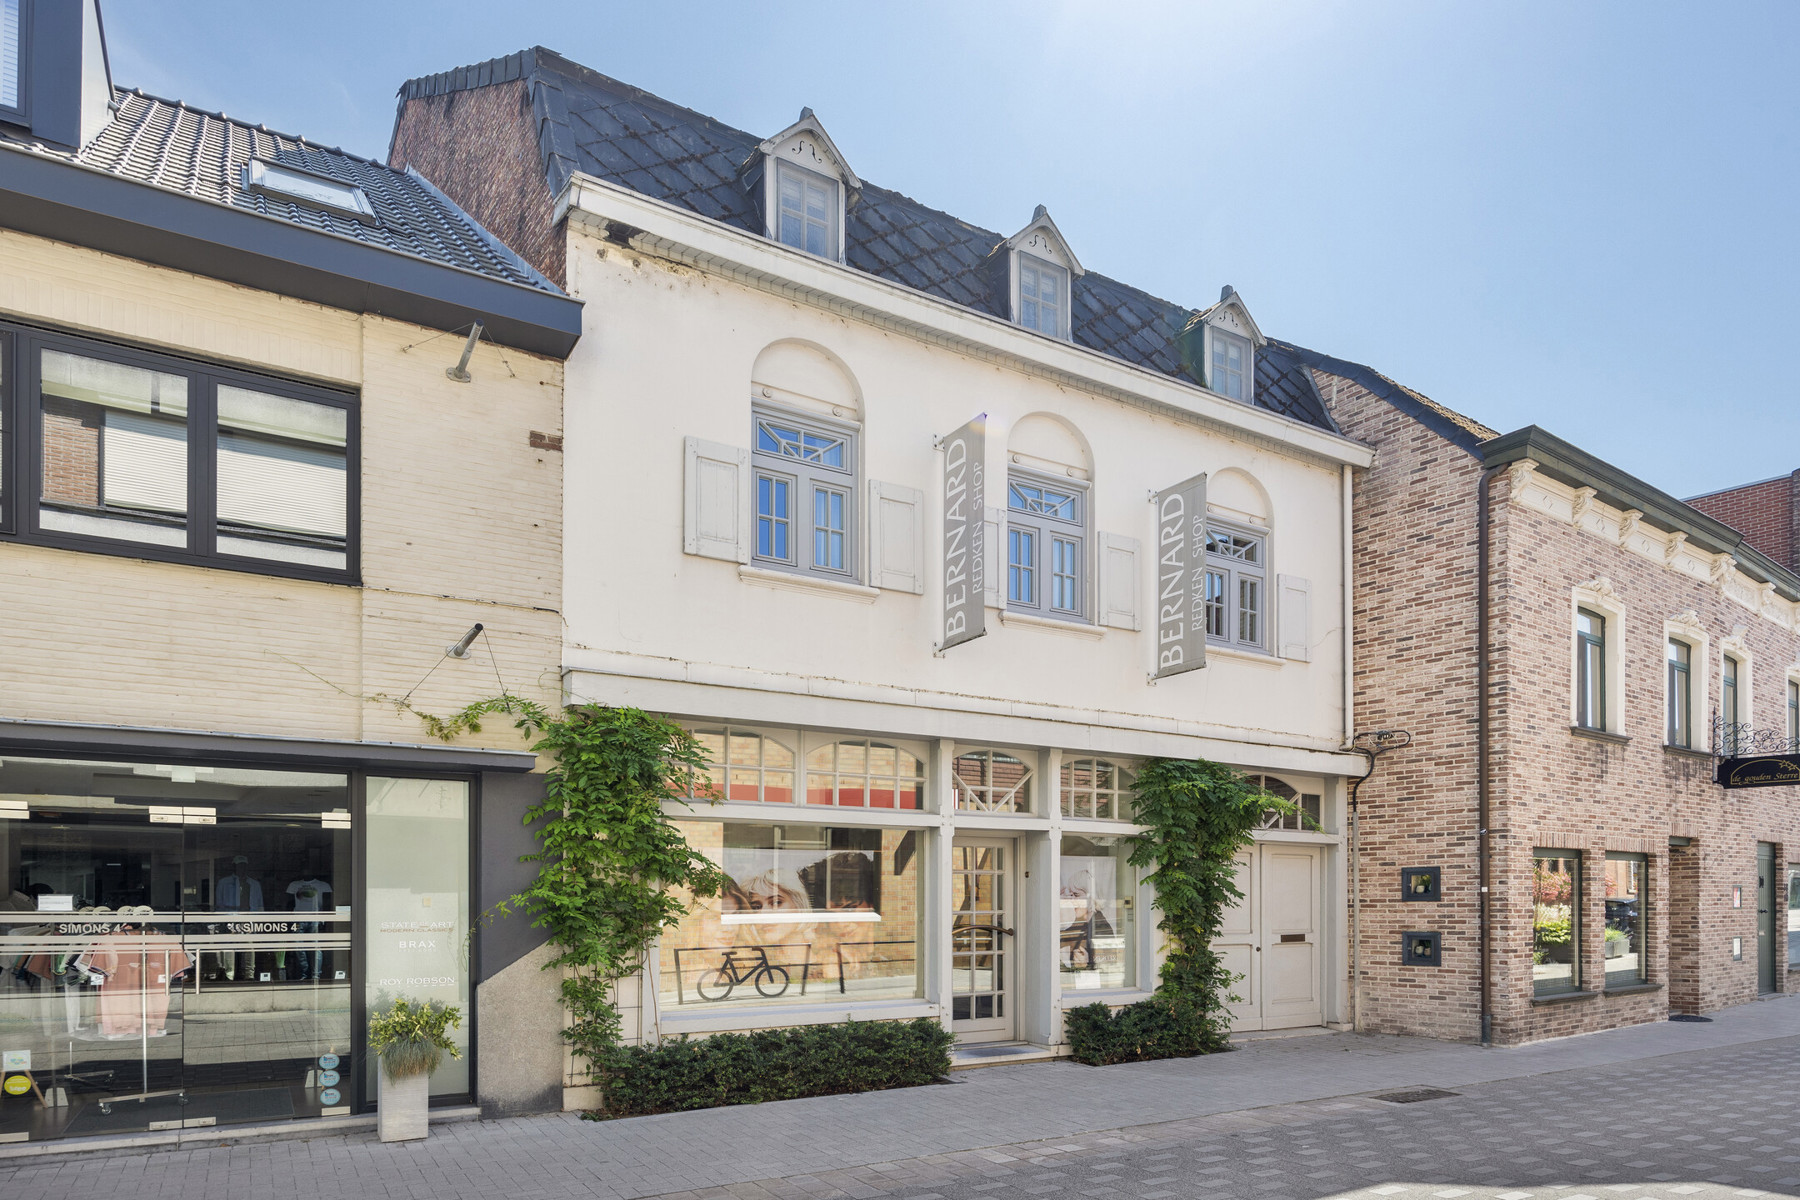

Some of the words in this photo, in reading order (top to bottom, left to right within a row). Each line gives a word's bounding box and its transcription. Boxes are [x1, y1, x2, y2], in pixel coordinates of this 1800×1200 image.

[973, 462, 983, 511] SHOP
[946, 438, 967, 638] BERNARD
[973, 521, 983, 594] REDKEN
[1192, 515, 1203, 558] SHOP
[1160, 493, 1185, 669] BERNARD
[1192, 567, 1204, 631] REDKEN
[59, 924, 111, 934] SIMONS
[113, 924, 122, 933] 4
[243, 923, 288, 933] SIMONS
[290, 923, 298, 932] 4
[399, 940, 436, 949] BRAX
[379, 978, 402, 986] ROY
[406, 976, 455, 985] ROBSON
